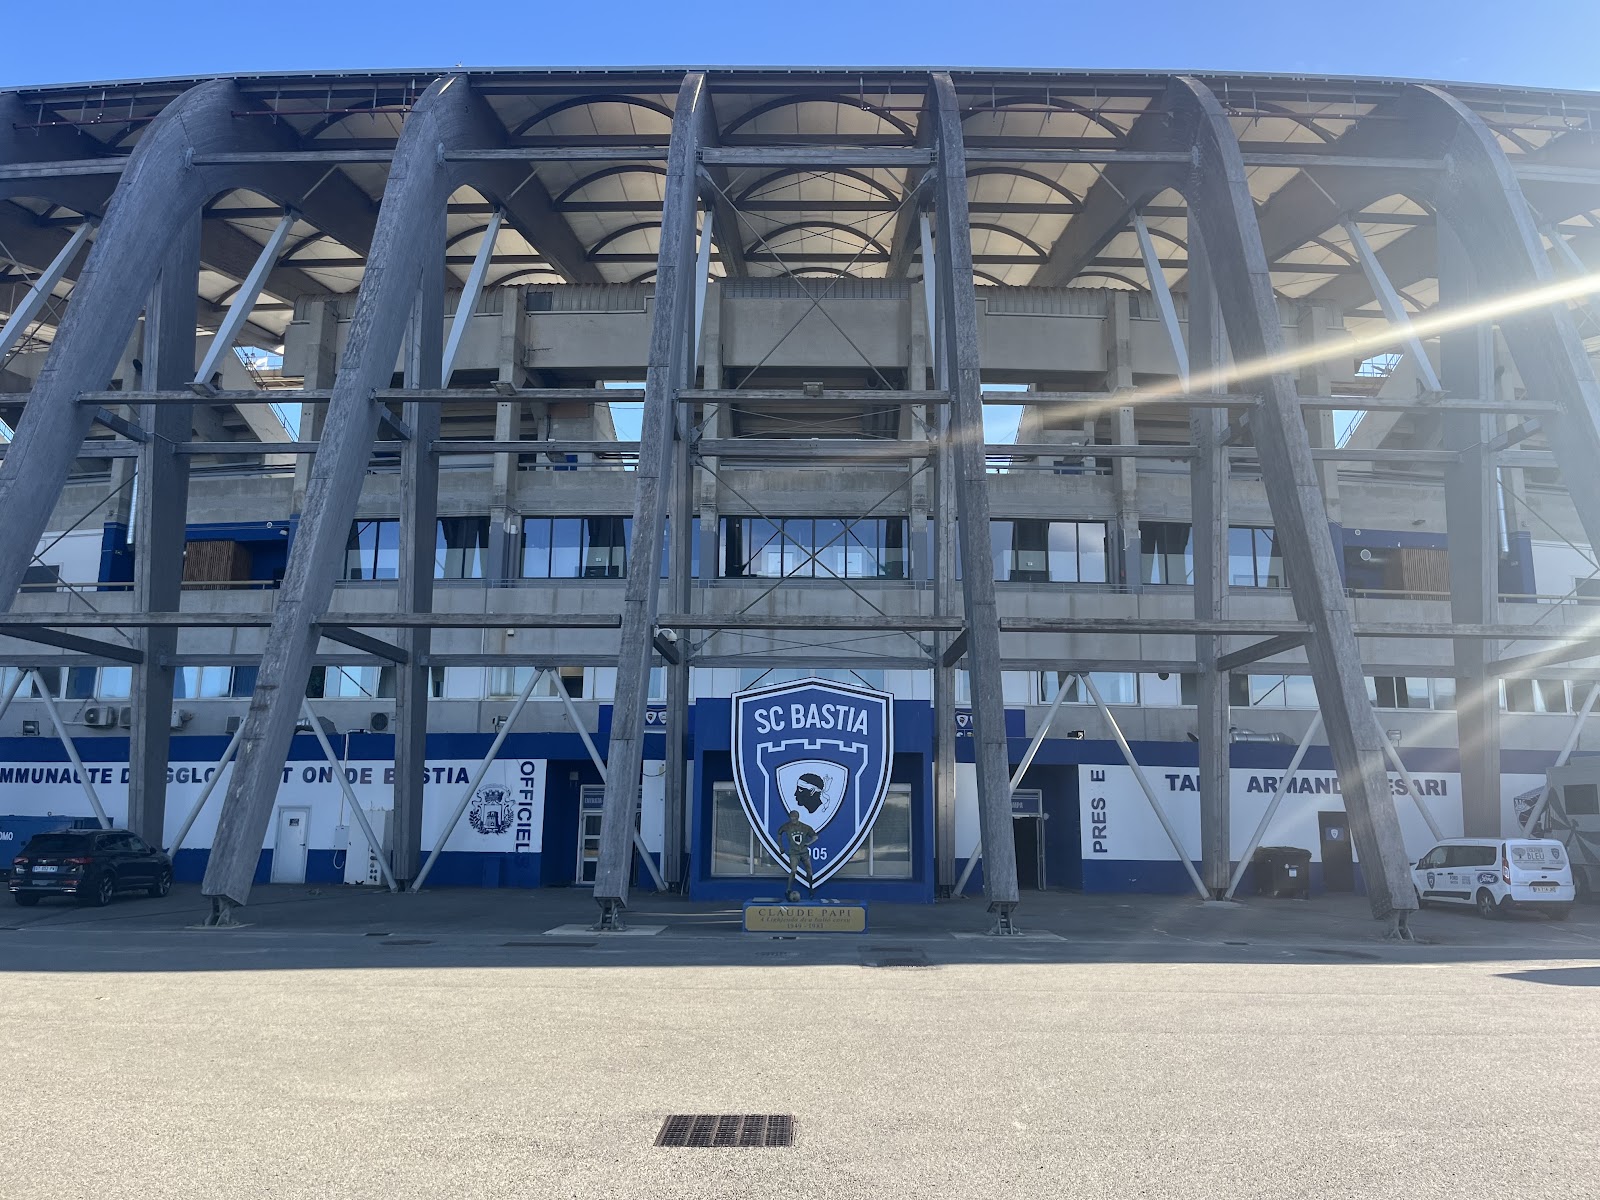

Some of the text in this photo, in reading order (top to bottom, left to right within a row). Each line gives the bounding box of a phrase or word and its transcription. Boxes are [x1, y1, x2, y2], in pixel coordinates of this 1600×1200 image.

[754, 703, 868, 736] SC BASTIA
[0, 767, 113, 784] MMUNAUTE
[345, 768, 373, 785] DE
[383, 767, 470, 785] BSTIA
[758, 908, 851, 917] CLAUDE PAPI
